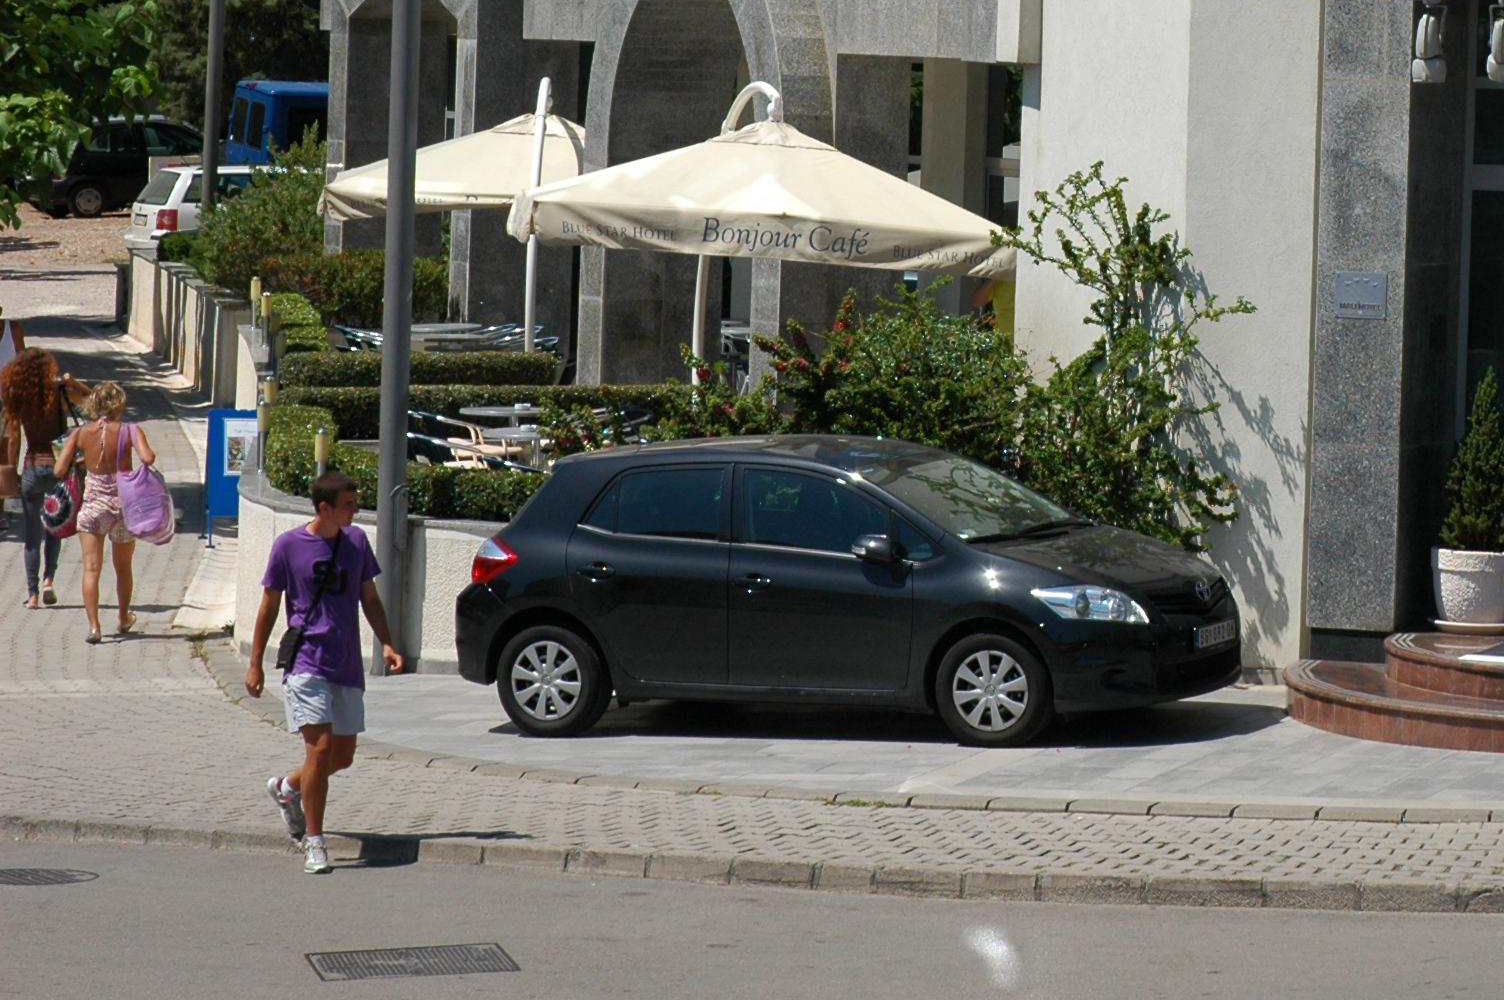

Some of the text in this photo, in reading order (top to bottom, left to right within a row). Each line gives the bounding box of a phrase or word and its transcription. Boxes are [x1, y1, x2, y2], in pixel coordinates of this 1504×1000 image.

[562, 221, 677, 240] BLUE STAR HOTEL
[702, 216, 870, 260] Bonjour Café
[893, 244, 1005, 268] BLUE STAR HOTEL
